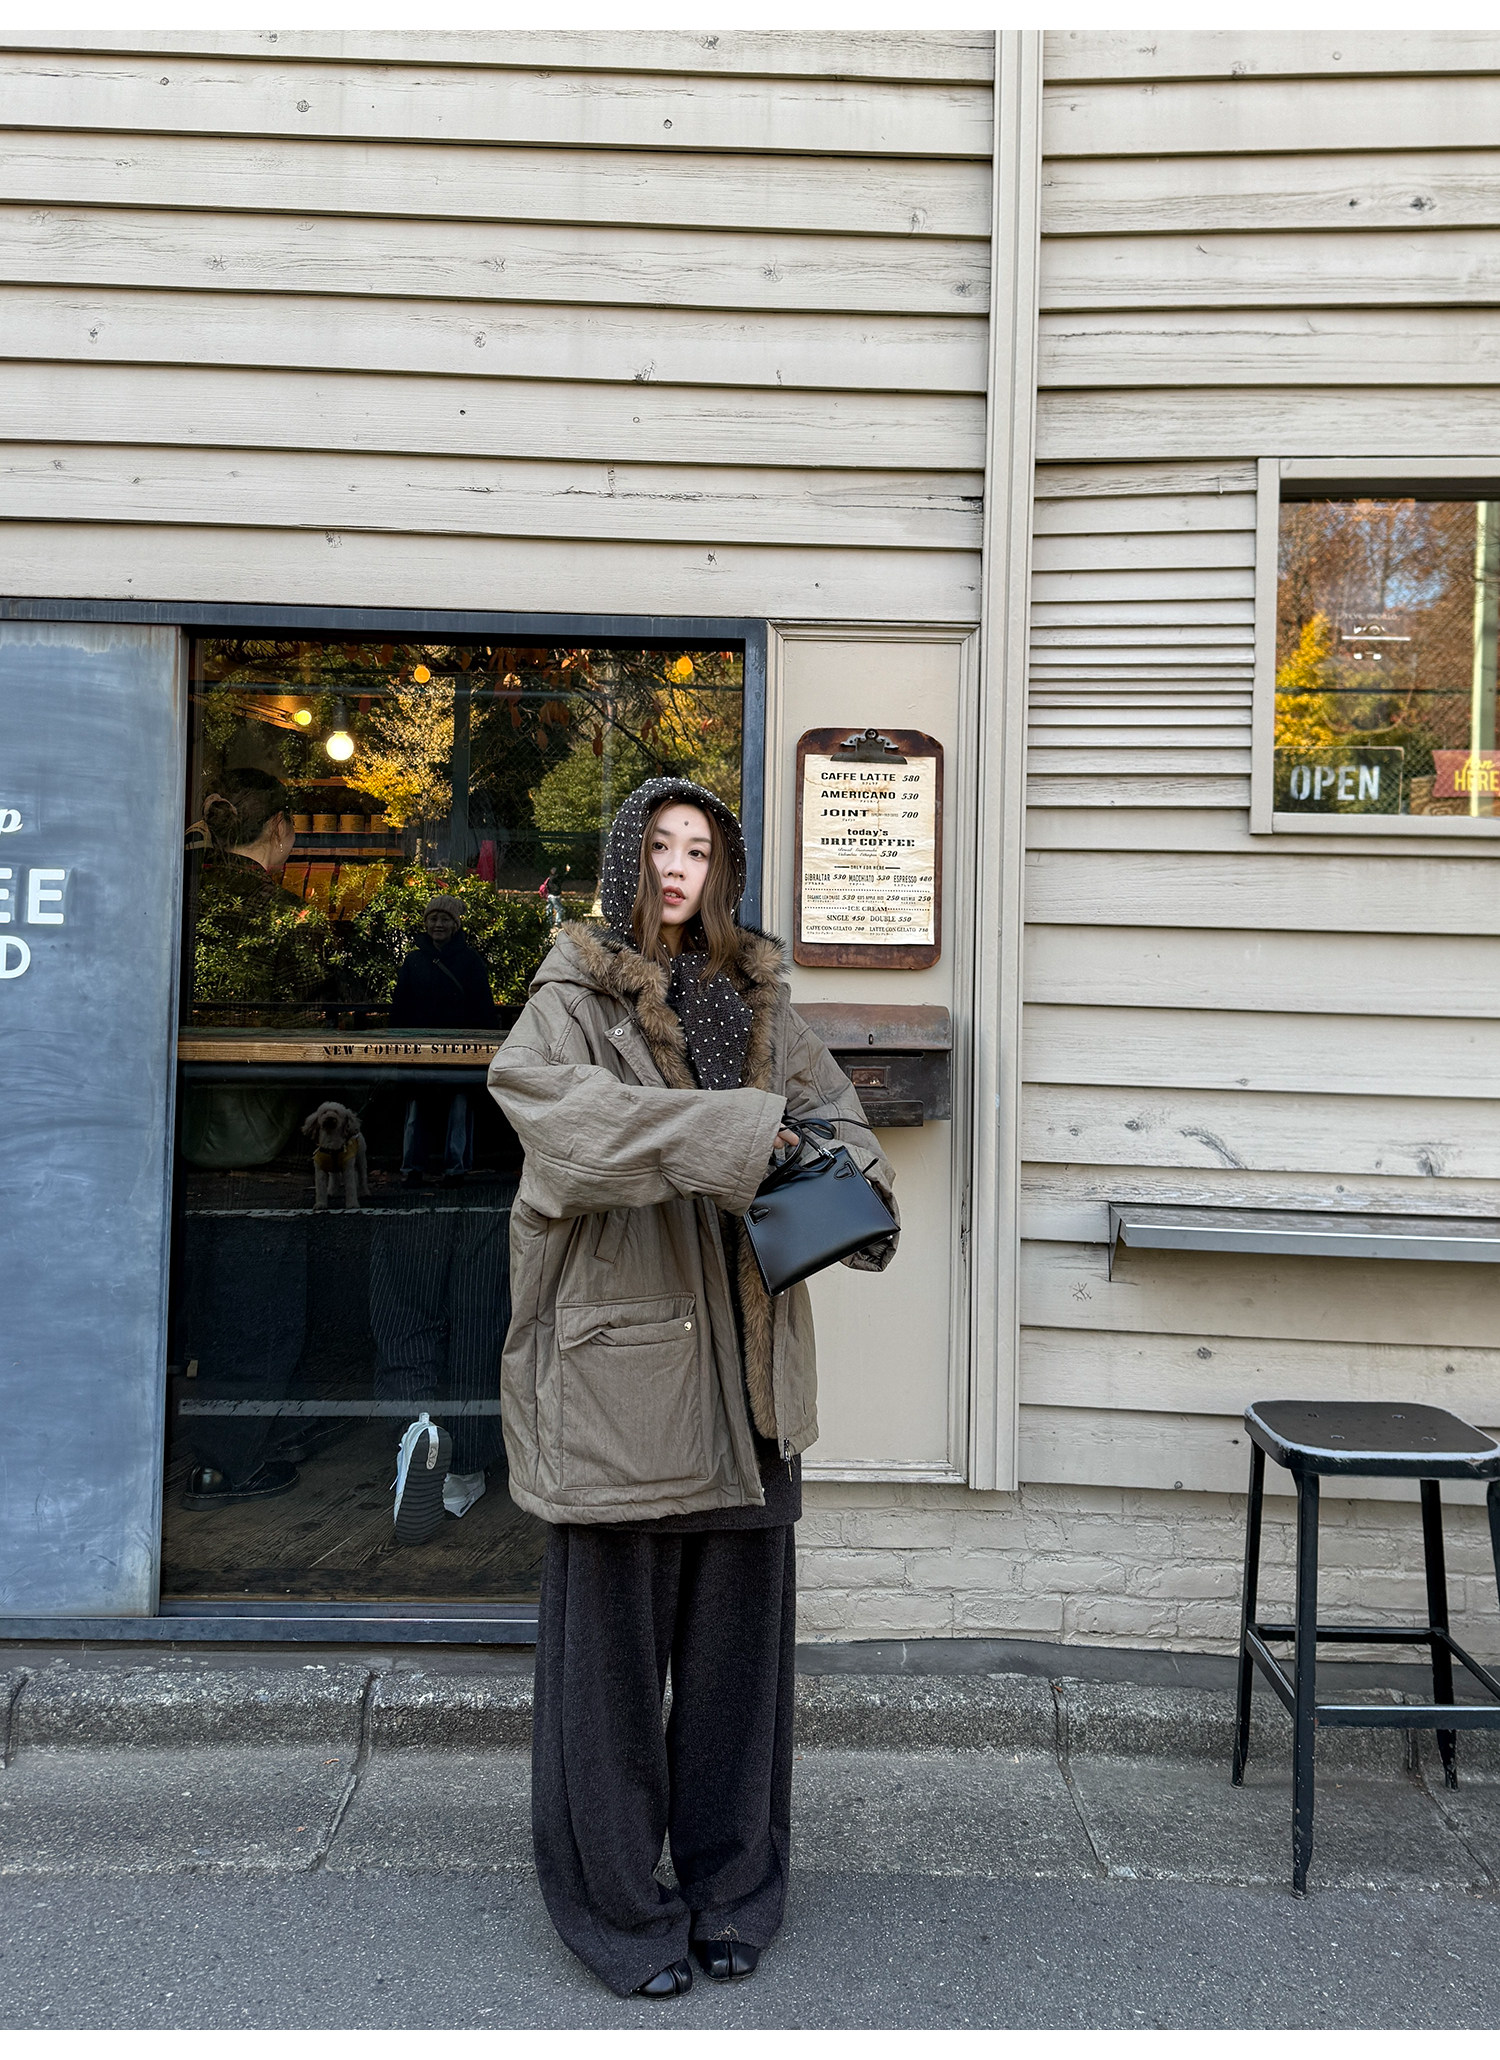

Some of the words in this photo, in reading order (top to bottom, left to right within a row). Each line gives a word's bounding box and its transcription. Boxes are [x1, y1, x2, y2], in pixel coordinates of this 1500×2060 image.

[821, 772, 856, 780] CAFFE
[860, 773, 896, 782] LATTE
[1454, 769, 1500, 792] HERE
[1290, 765, 1380, 801] OPEN
[821, 790, 896, 799] AMERICANO
[820, 809, 869, 817] JOINT
[847, 828, 889, 837] today's
[820, 837, 857, 845] DRIP
[859, 838, 915, 847] COFFEE
[880, 850, 898, 858] 530
[804, 873, 831, 882] GIBRALTAR
[848, 874, 875, 883] MACCHIATO
[893, 874, 918, 884] ESPRESSO
[869, 915, 897, 923] DOUBLE
[323, 1045, 355, 1056] NEW
[363, 1044, 422, 1055] COFFEE
